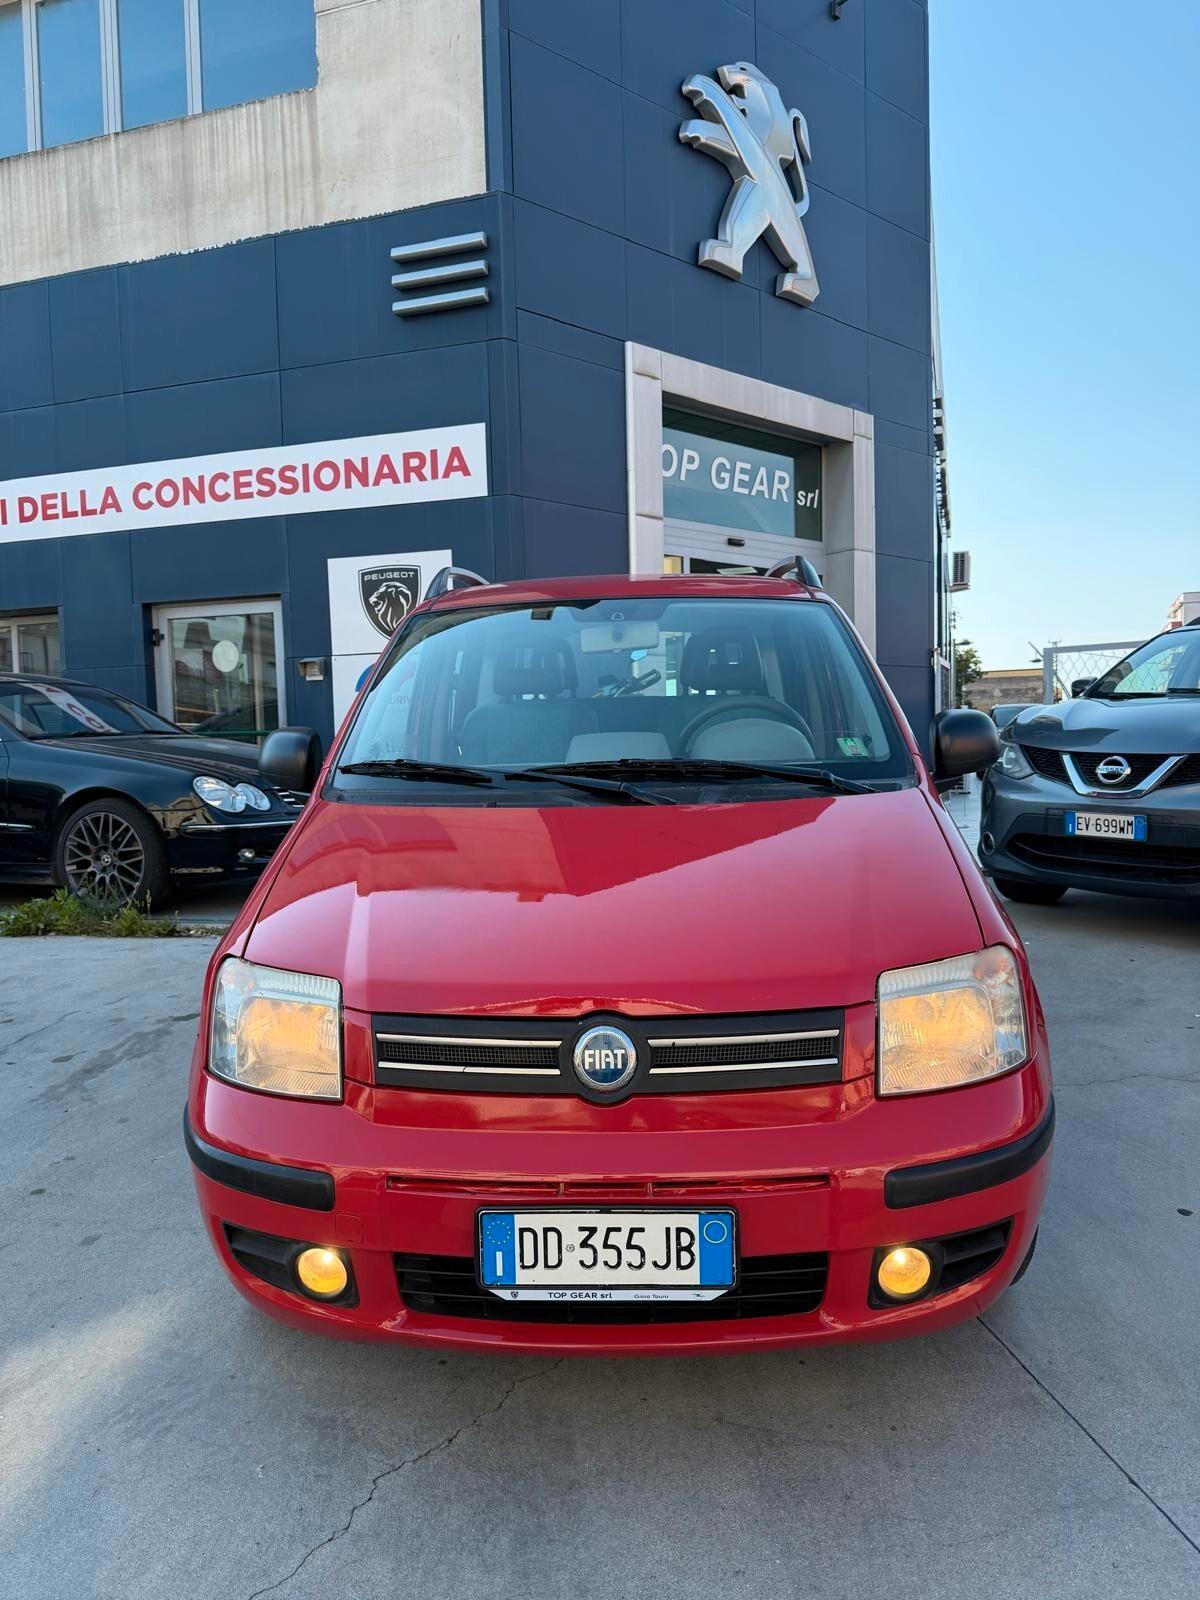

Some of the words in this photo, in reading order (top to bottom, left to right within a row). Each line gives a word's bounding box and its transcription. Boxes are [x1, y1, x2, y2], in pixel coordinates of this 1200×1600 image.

[18, 485, 122, 524] DELLA
[132, 446, 472, 512] CONCESSIONARIA
[662, 443, 700, 481] OP
[710, 456, 791, 503] GEAR
[796, 489, 820, 509] srl
[364, 571, 415, 582] PEUGEOT
[584, 1049, 626, 1070] FIAT
[548, 1291, 567, 1299] TOP
[570, 1291, 597, 1299] GEAR
[600, 1291, 613, 1299] srl
